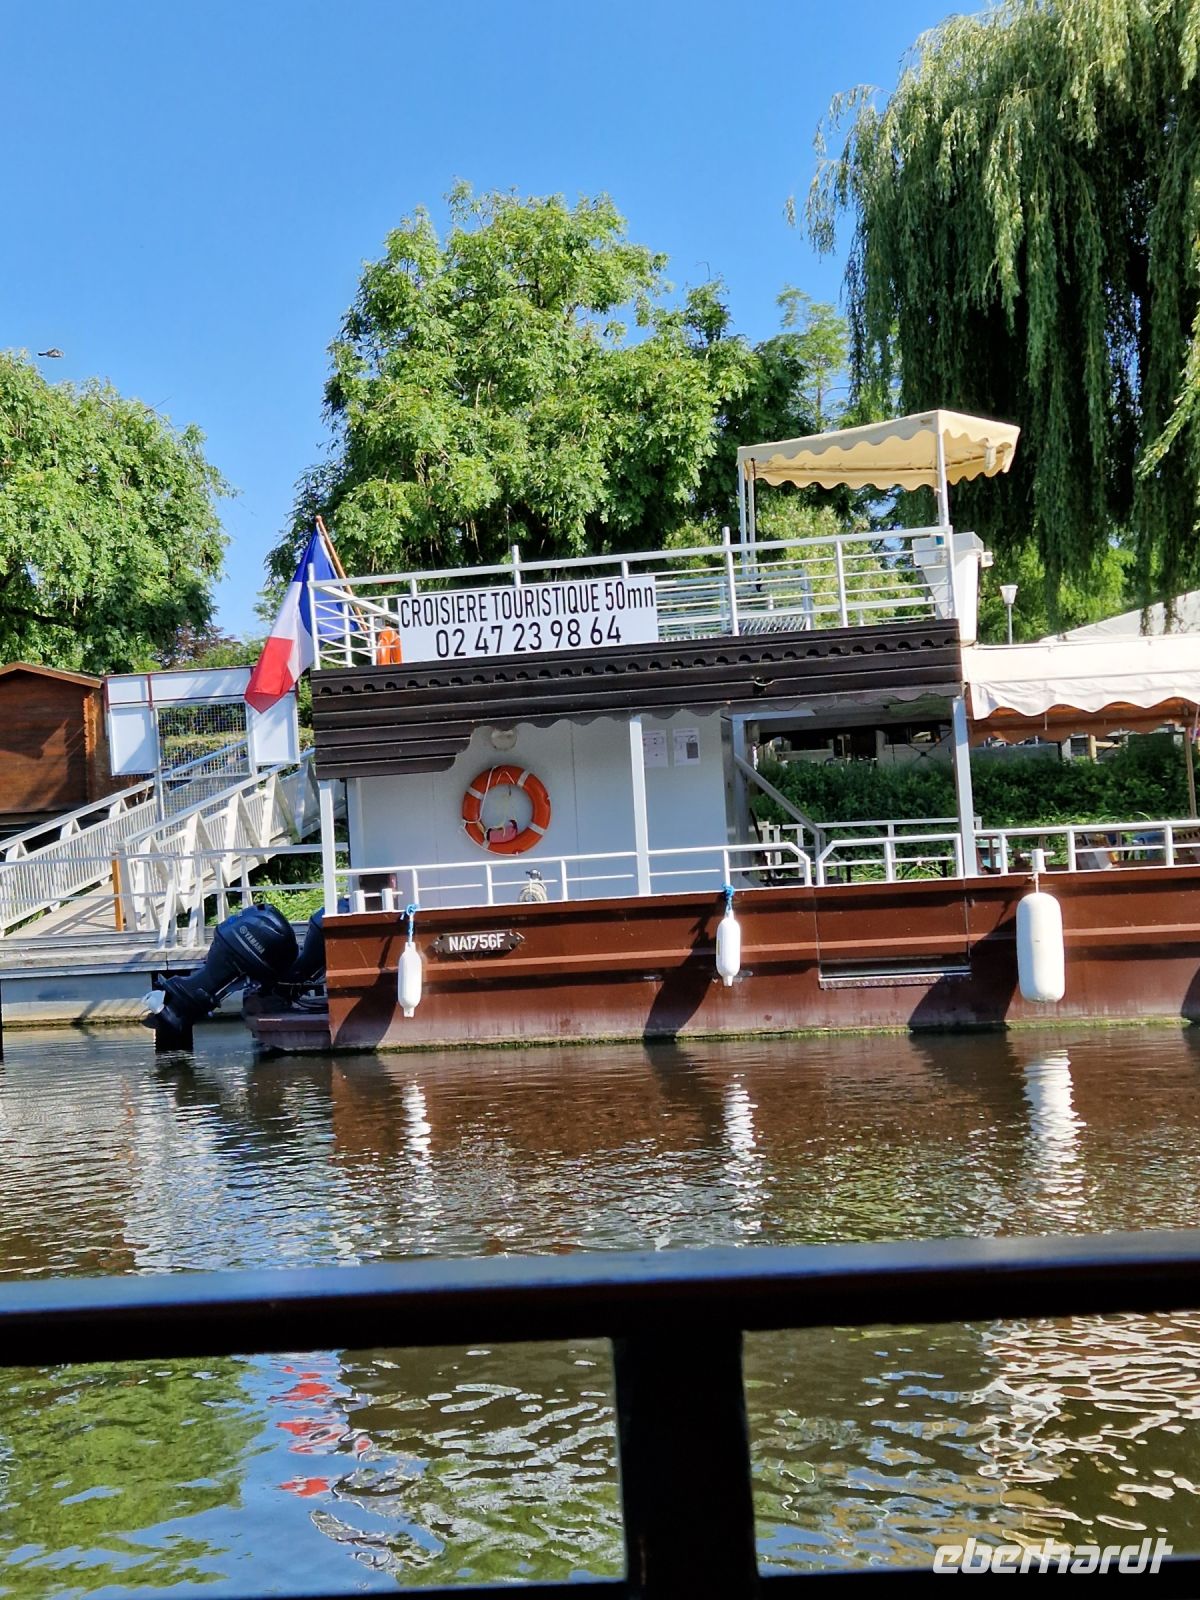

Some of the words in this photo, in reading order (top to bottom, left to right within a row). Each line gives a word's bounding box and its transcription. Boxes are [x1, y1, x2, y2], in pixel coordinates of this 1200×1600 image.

[400, 593, 488, 629] CROISIERE
[491, 583, 599, 620] TOURISTIQUE
[604, 581, 654, 611] 50mn
[435, 628, 466, 658] 02
[474, 626, 504, 655] 47
[512, 621, 543, 652] 23
[549, 618, 582, 648] 98
[589, 614, 622, 644] 64
[244, 931, 265, 955] YAMAHA
